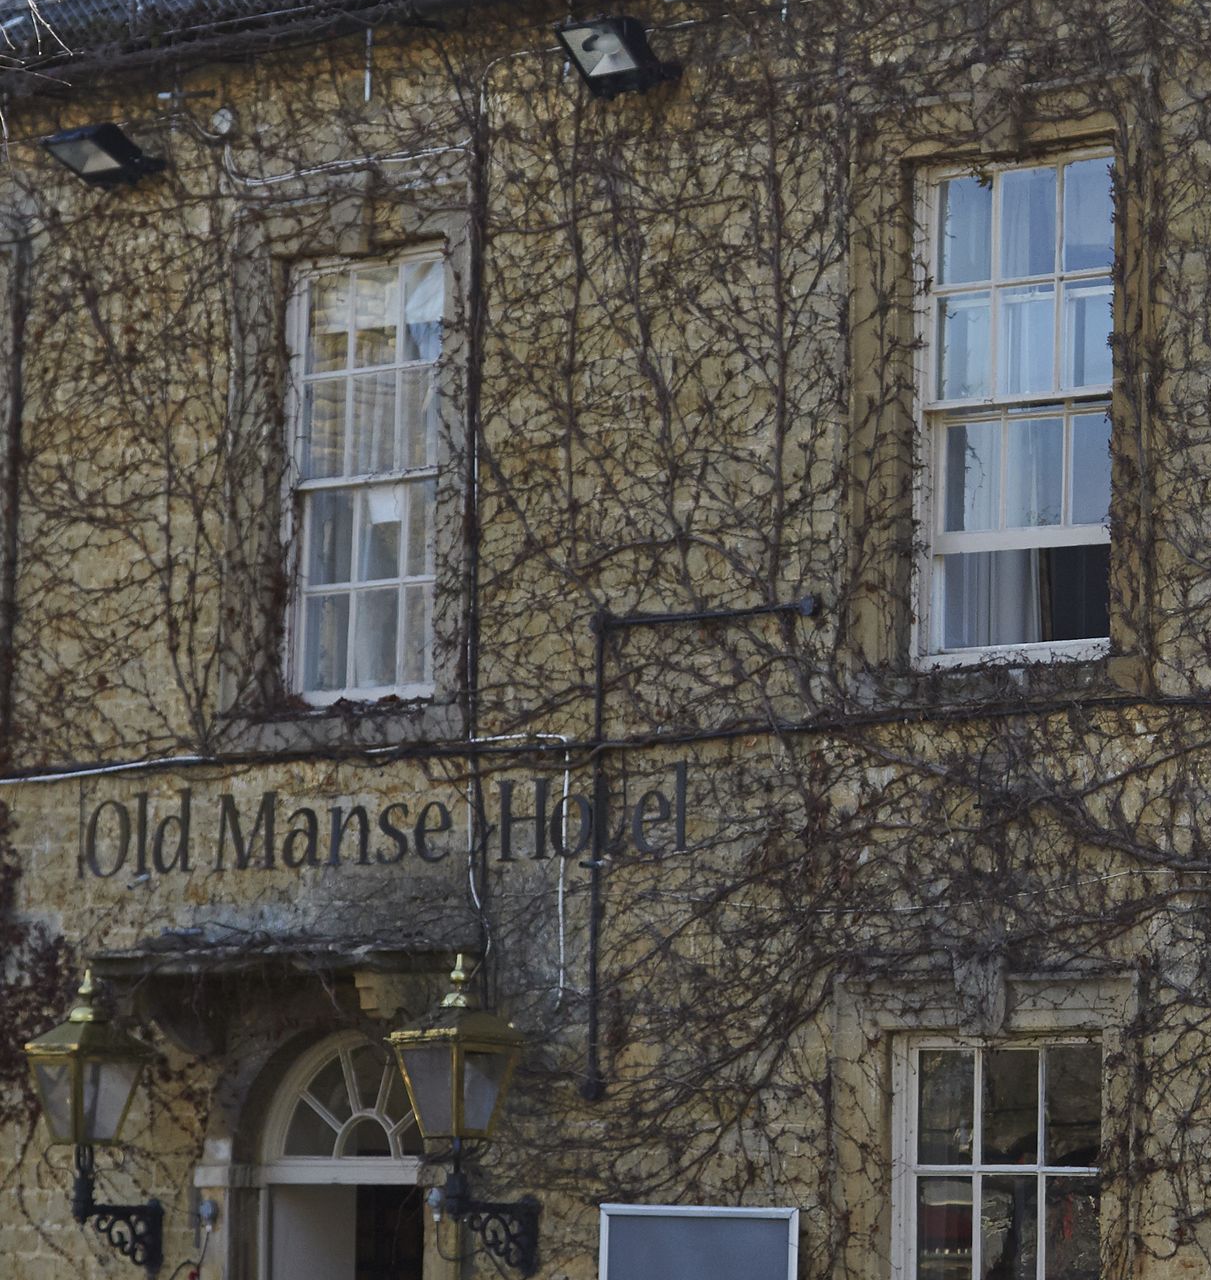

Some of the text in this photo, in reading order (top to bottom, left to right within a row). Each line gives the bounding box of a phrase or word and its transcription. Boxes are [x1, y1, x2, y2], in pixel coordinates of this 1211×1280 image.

[84, 759, 688, 879] Old Manse Hotel
